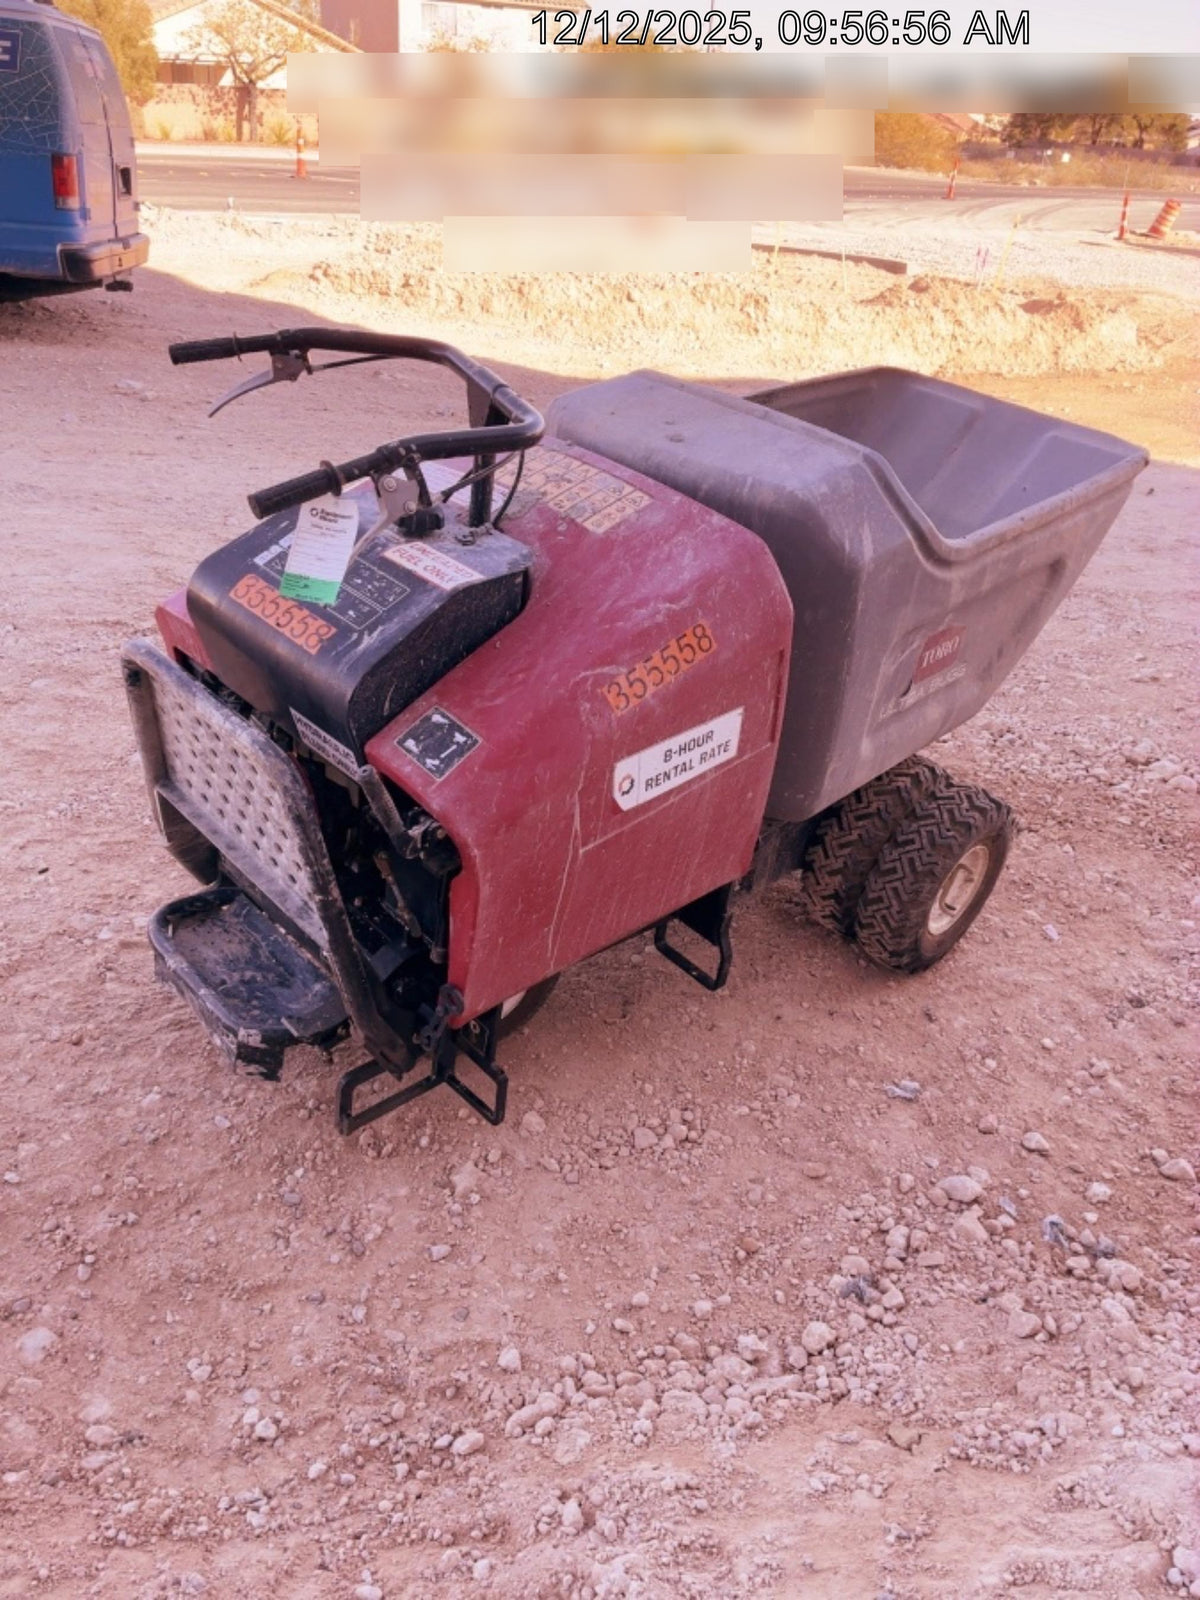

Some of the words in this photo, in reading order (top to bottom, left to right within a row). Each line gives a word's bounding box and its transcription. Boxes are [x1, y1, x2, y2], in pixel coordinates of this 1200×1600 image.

[233, 577, 333, 652] 355558
[606, 623, 713, 711] 355558
[644, 762, 695, 792] RENTAL
[699, 740, 732, 765] RATE
[663, 730, 715, 763] 8-HOUR
